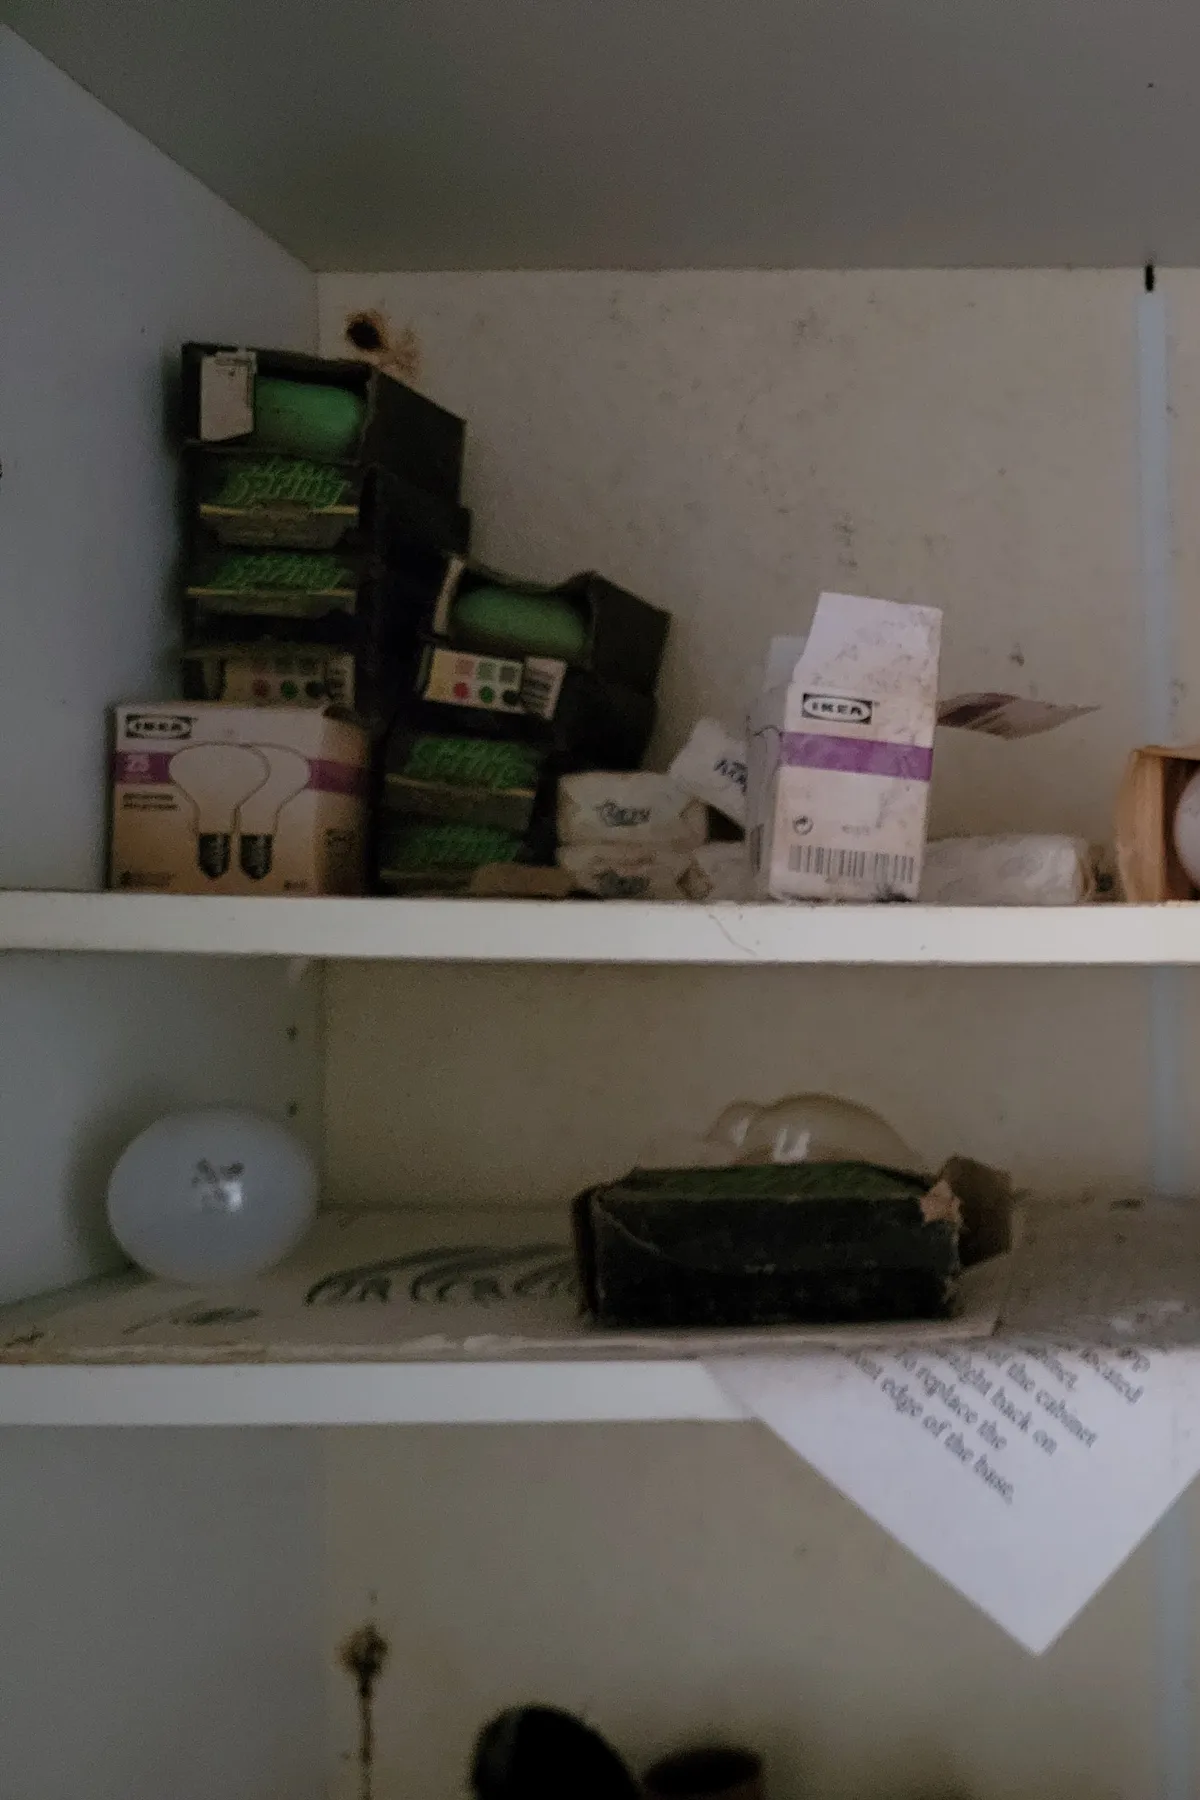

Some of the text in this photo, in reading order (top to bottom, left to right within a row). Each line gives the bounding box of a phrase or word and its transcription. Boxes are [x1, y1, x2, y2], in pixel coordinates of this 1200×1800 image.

[880, 1377, 924, 1418] edge
[921, 1414, 952, 1439] of
[944, 1431, 975, 1465] the
[972, 1453, 1015, 1508] base.
[914, 1366, 979, 1424] replace
[976, 1419, 1008, 1452] the
[990, 1385, 1034, 1433] back
[1032, 1429, 1058, 1456] on
[1006, 1362, 1036, 1393] the
[1034, 1389, 1098, 1448] cabinet
